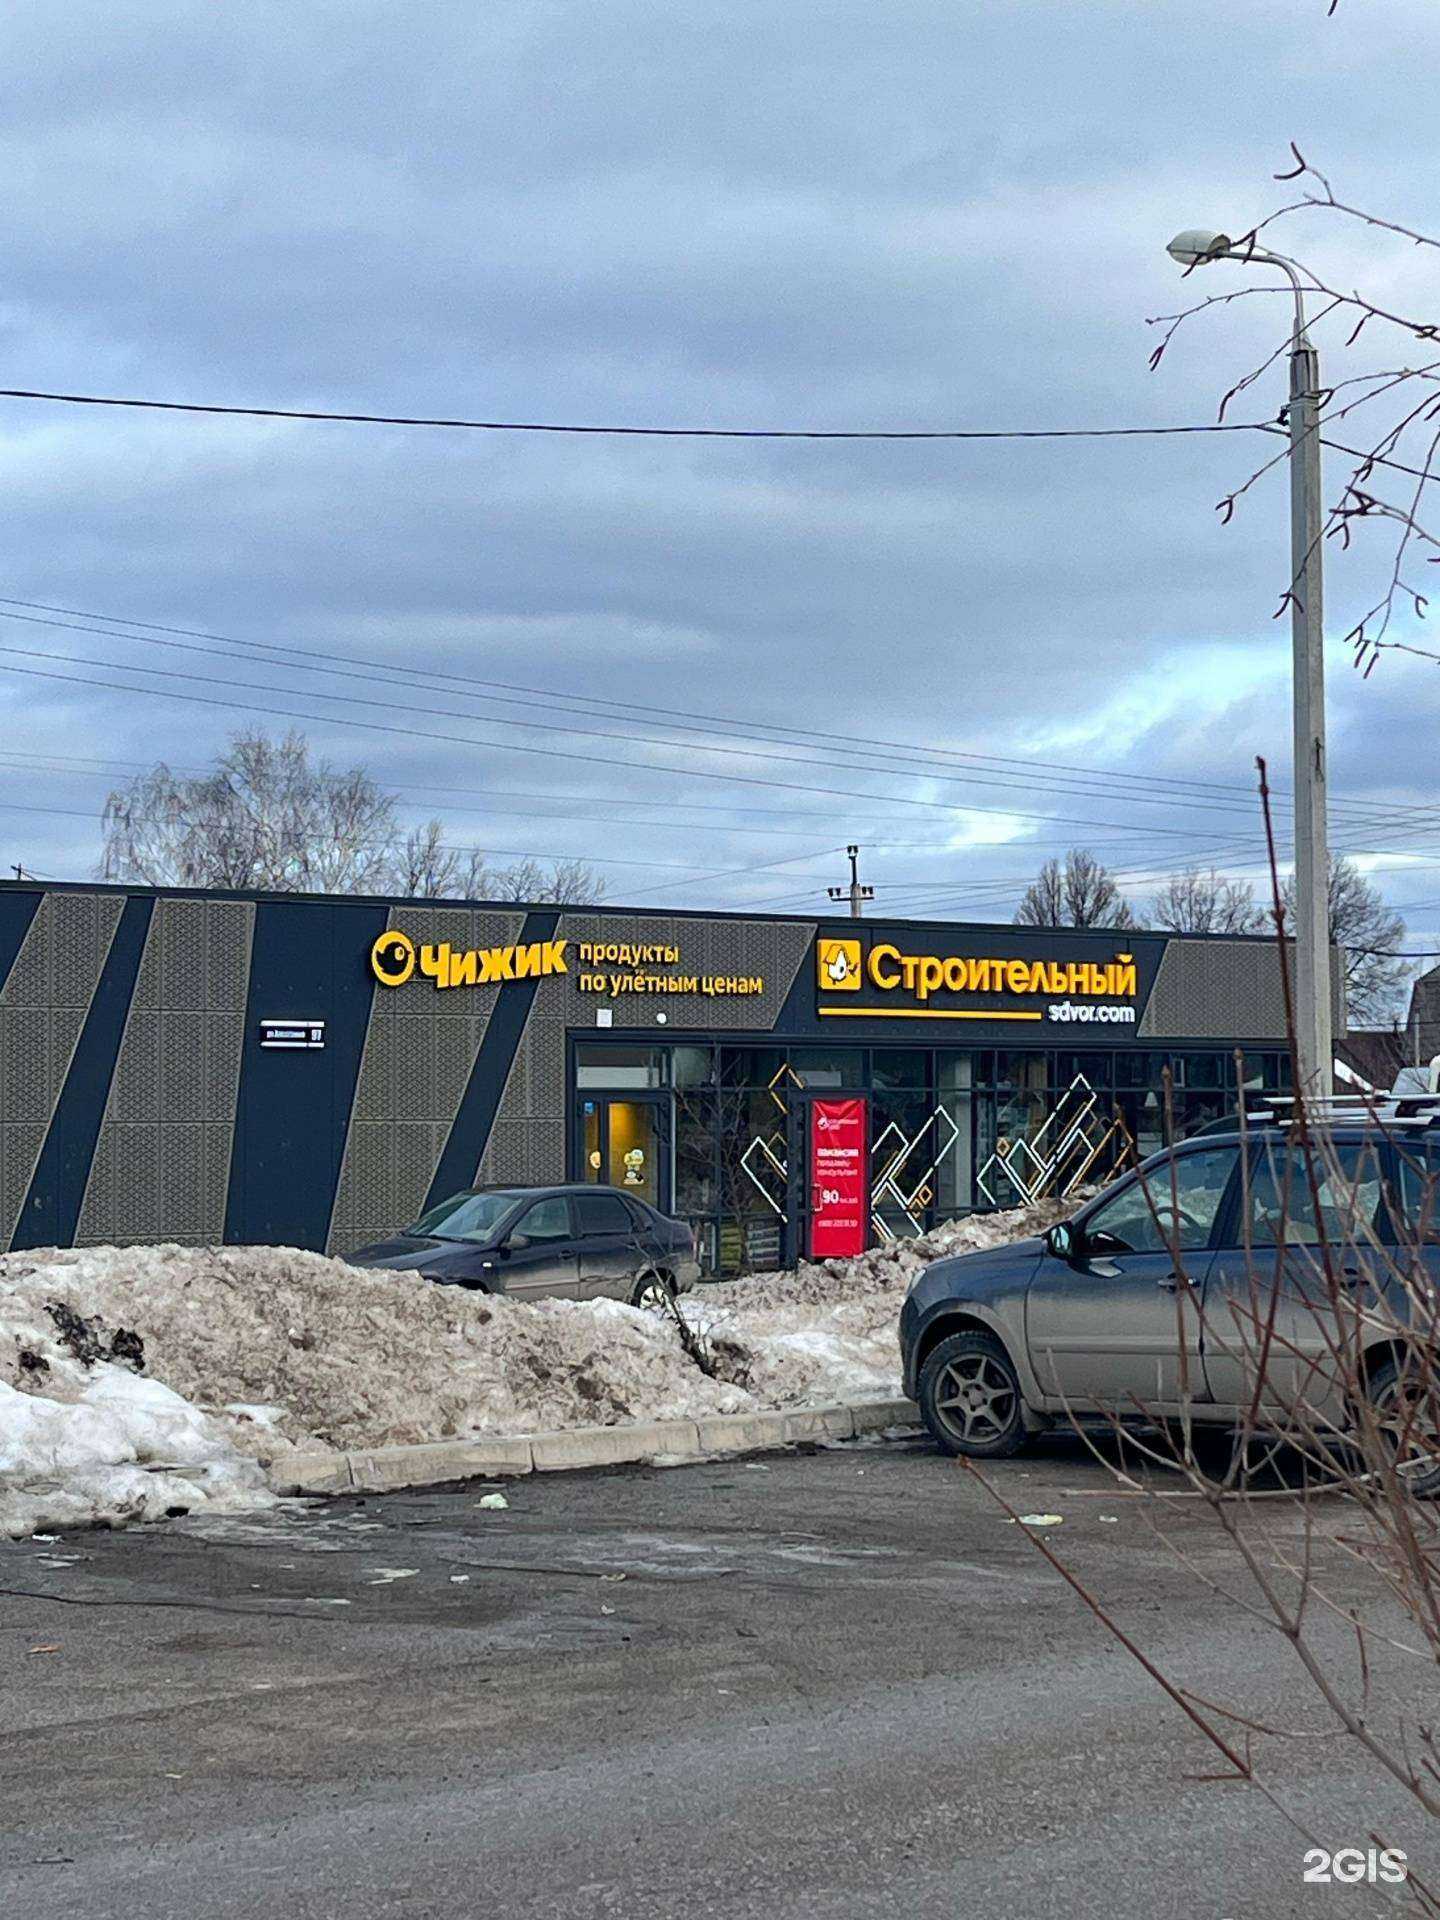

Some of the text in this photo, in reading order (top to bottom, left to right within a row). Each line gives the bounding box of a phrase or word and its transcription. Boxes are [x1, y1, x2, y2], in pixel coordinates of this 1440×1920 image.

[579, 943, 679, 966] продукты
[867, 943, 1137, 1000] Строительный
[579, 969, 763, 998] по улётным ценам
[1048, 1001, 1136, 1024] sdvor.com
[822, 1189, 839, 1204] 90
